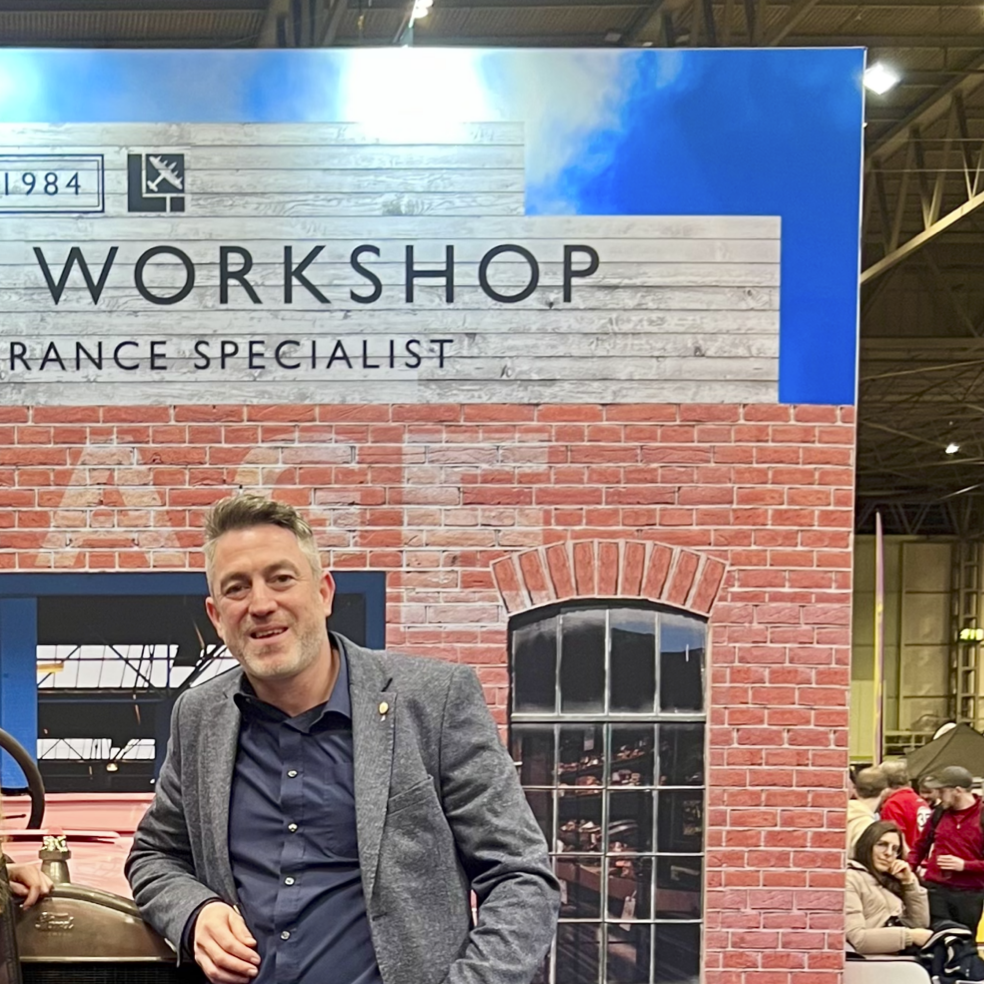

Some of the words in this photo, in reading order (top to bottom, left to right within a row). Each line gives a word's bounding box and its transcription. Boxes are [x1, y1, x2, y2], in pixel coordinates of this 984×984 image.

[4, 172, 82, 196] 1984
[32, 243, 600, 305] WORKSHOP
[194, 338, 455, 370] SPECIALIST
